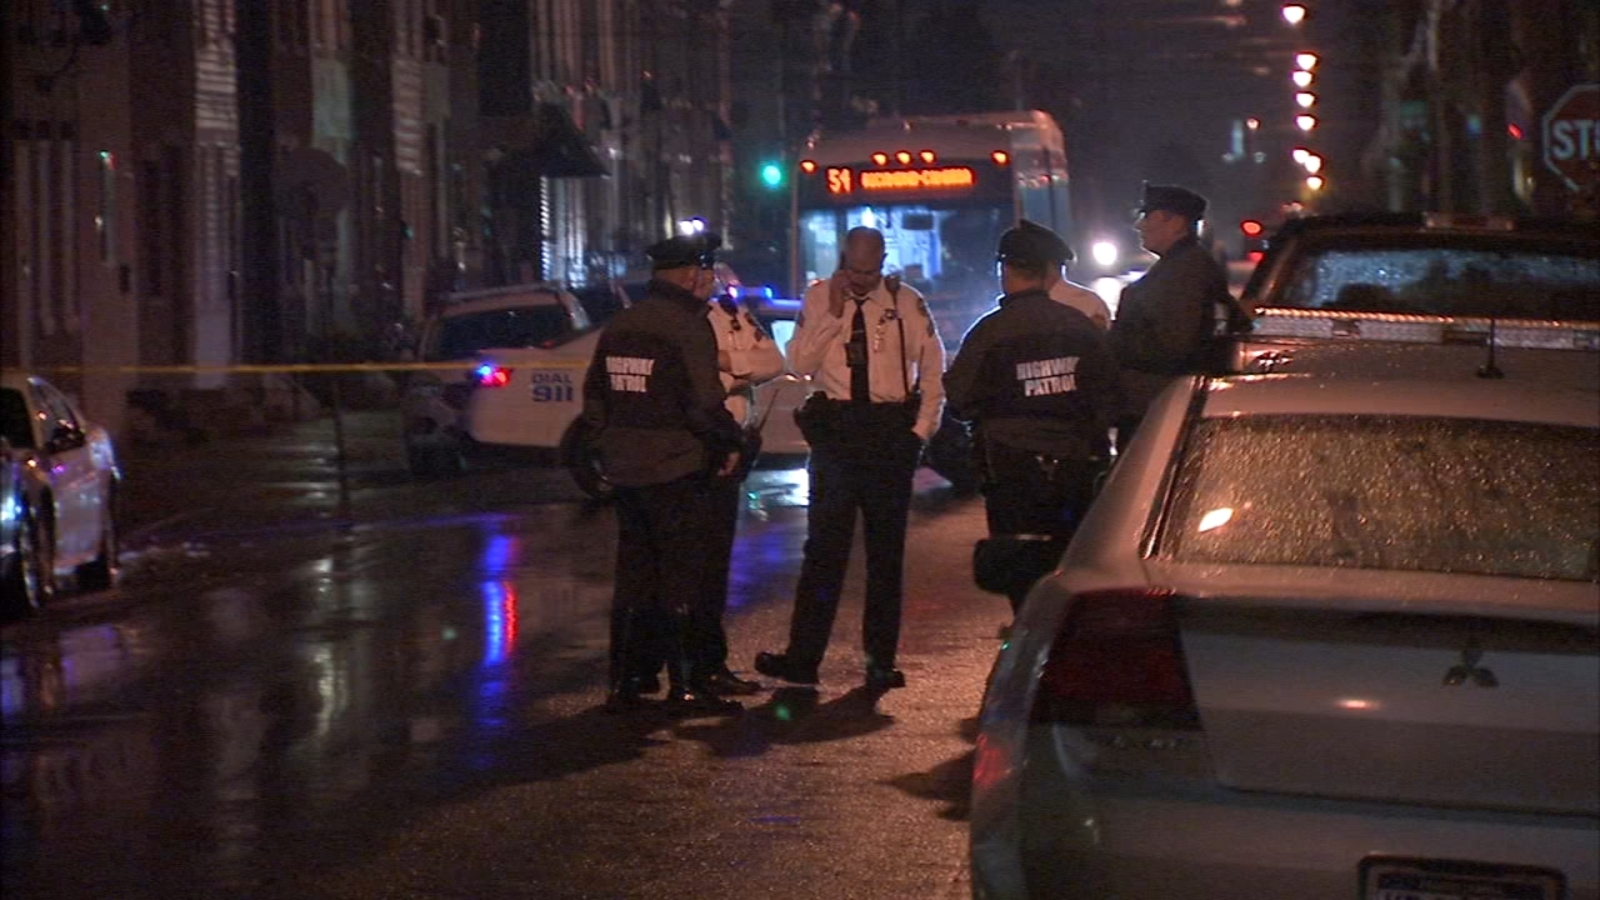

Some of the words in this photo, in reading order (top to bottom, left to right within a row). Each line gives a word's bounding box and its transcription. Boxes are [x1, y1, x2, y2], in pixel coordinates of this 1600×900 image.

[532, 373, 573, 384] DIAL
[1025, 374, 1076, 396] PATROL
[532, 386, 573, 401] 911
